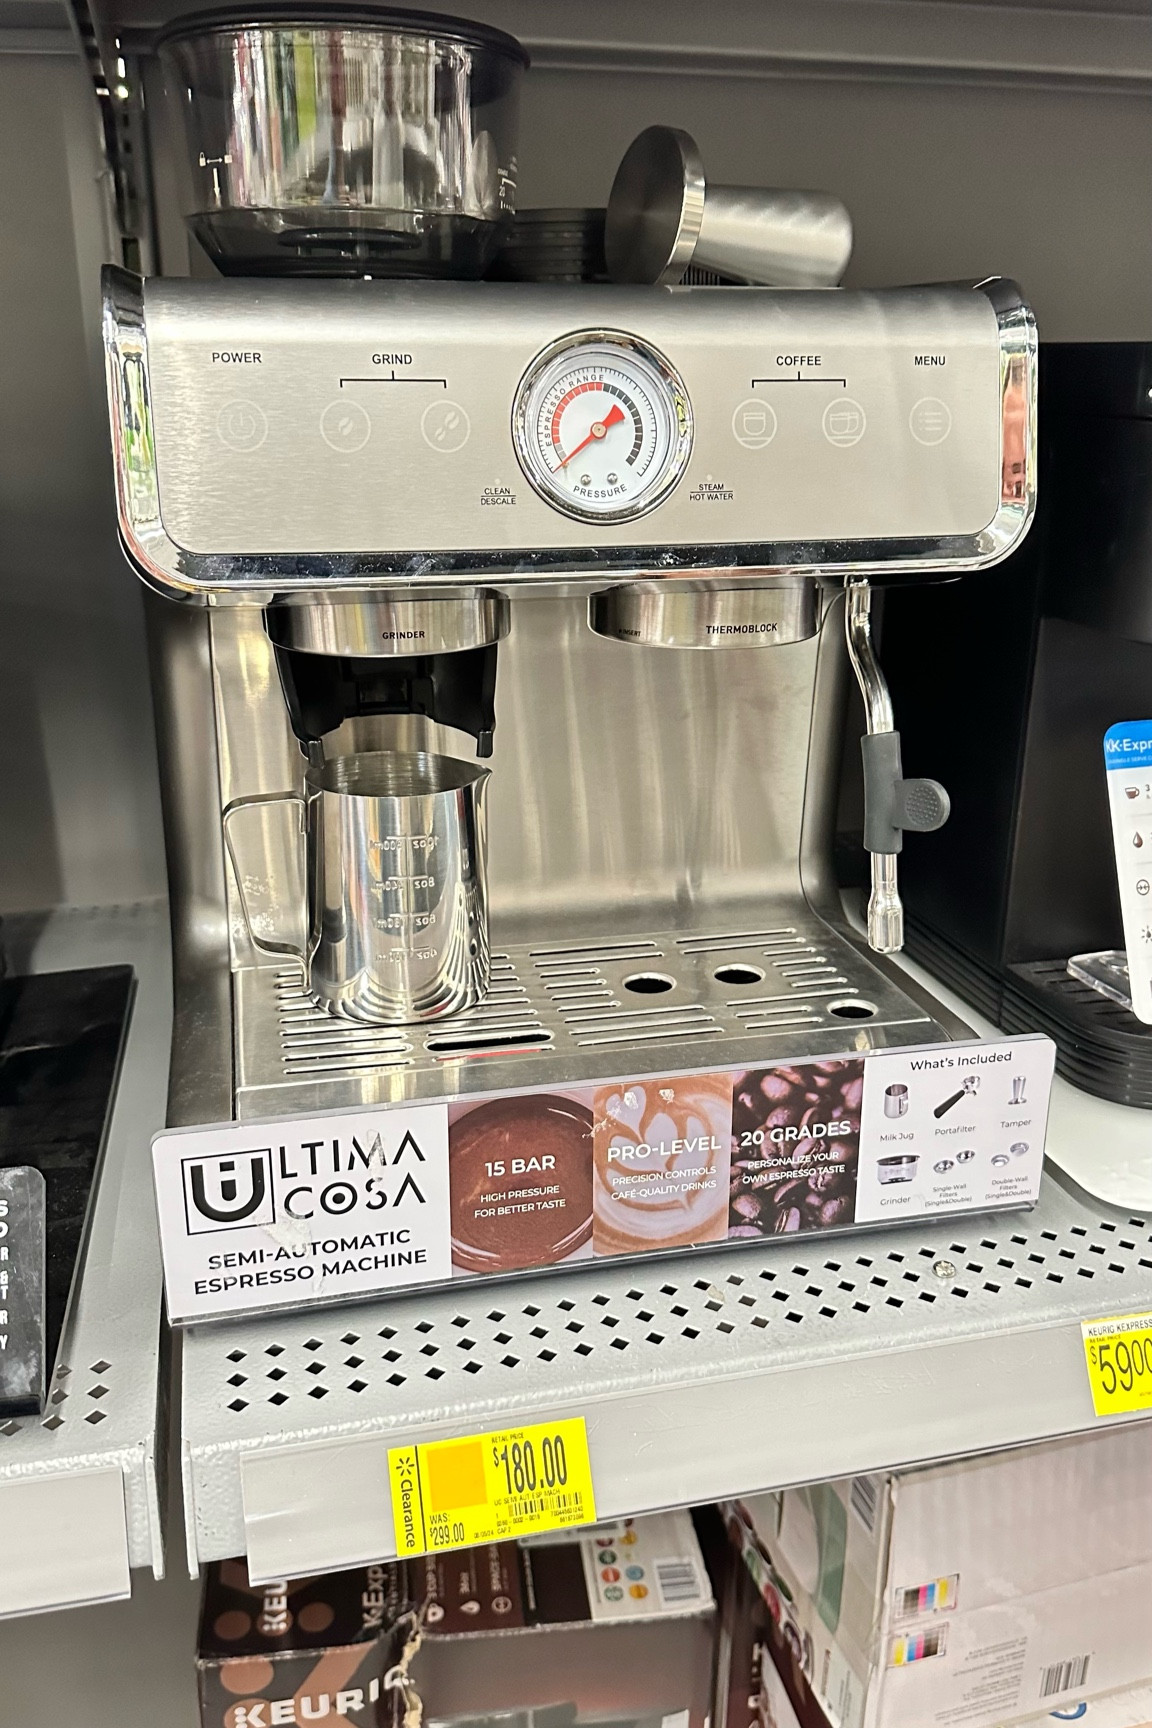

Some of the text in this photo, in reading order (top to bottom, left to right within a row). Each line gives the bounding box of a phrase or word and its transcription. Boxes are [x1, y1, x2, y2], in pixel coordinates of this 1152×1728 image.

[212, 352, 262, 364] POWER
[372, 353, 412, 365] GRIND
[776, 355, 822, 366] COFFEE
[914, 355, 946, 366] MENU
[546, 374, 605, 447] ESPRESSO RANGE
[484, 487, 511, 496] CLEAN
[573, 484, 627, 498] PRESSURE
[698, 483, 724, 491] STEAM
[480, 497, 517, 506] DESCALE
[689, 492, 734, 502] HOT WATER
[382, 630, 425, 640] GRINDER
[706, 622, 777, 634] THERMOBLOCK
[910, 1051, 1012, 1071] What's Included
[935, 1125, 976, 1136] Portafilter
[1000, 1119, 1032, 1129] Tamper
[740, 1120, 851, 1147] 20 GRADES
[880, 1132, 914, 1142] Milk Jug
[607, 1135, 721, 1162] PRO-LEVEL
[484, 1154, 556, 1177] 15 BAR
[747, 1151, 840, 1170] PERSONALIZE YOUR
[612, 1166, 717, 1186] PRECISION CONTROLS
[742, 1164, 845, 1184] OWN ESPRESSO TASTE
[284, 1172, 427, 1220] COSA
[480, 1185, 560, 1203] HIGH PRESSURE
[611, 1179, 717, 1201] CAFÉ-QUALITY DRINKS
[939, 1191, 958, 1199] Filters
[880, 1196, 911, 1206] Grinder
[474, 1198, 566, 1219] FOR BETTER TASTE
[208, 1229, 411, 1270] SEMI-AUTOMATIC
[194, 1249, 427, 1295] ESPRESSO MACHINE
[1088, 1326, 1115, 1337] KEURIG
[510, 1432, 524, 1440] PRICE
[493, 1435, 568, 1494] $180.00
[400, 1479, 415, 1548] Clearance
[430, 1522, 465, 1546] $299.00
